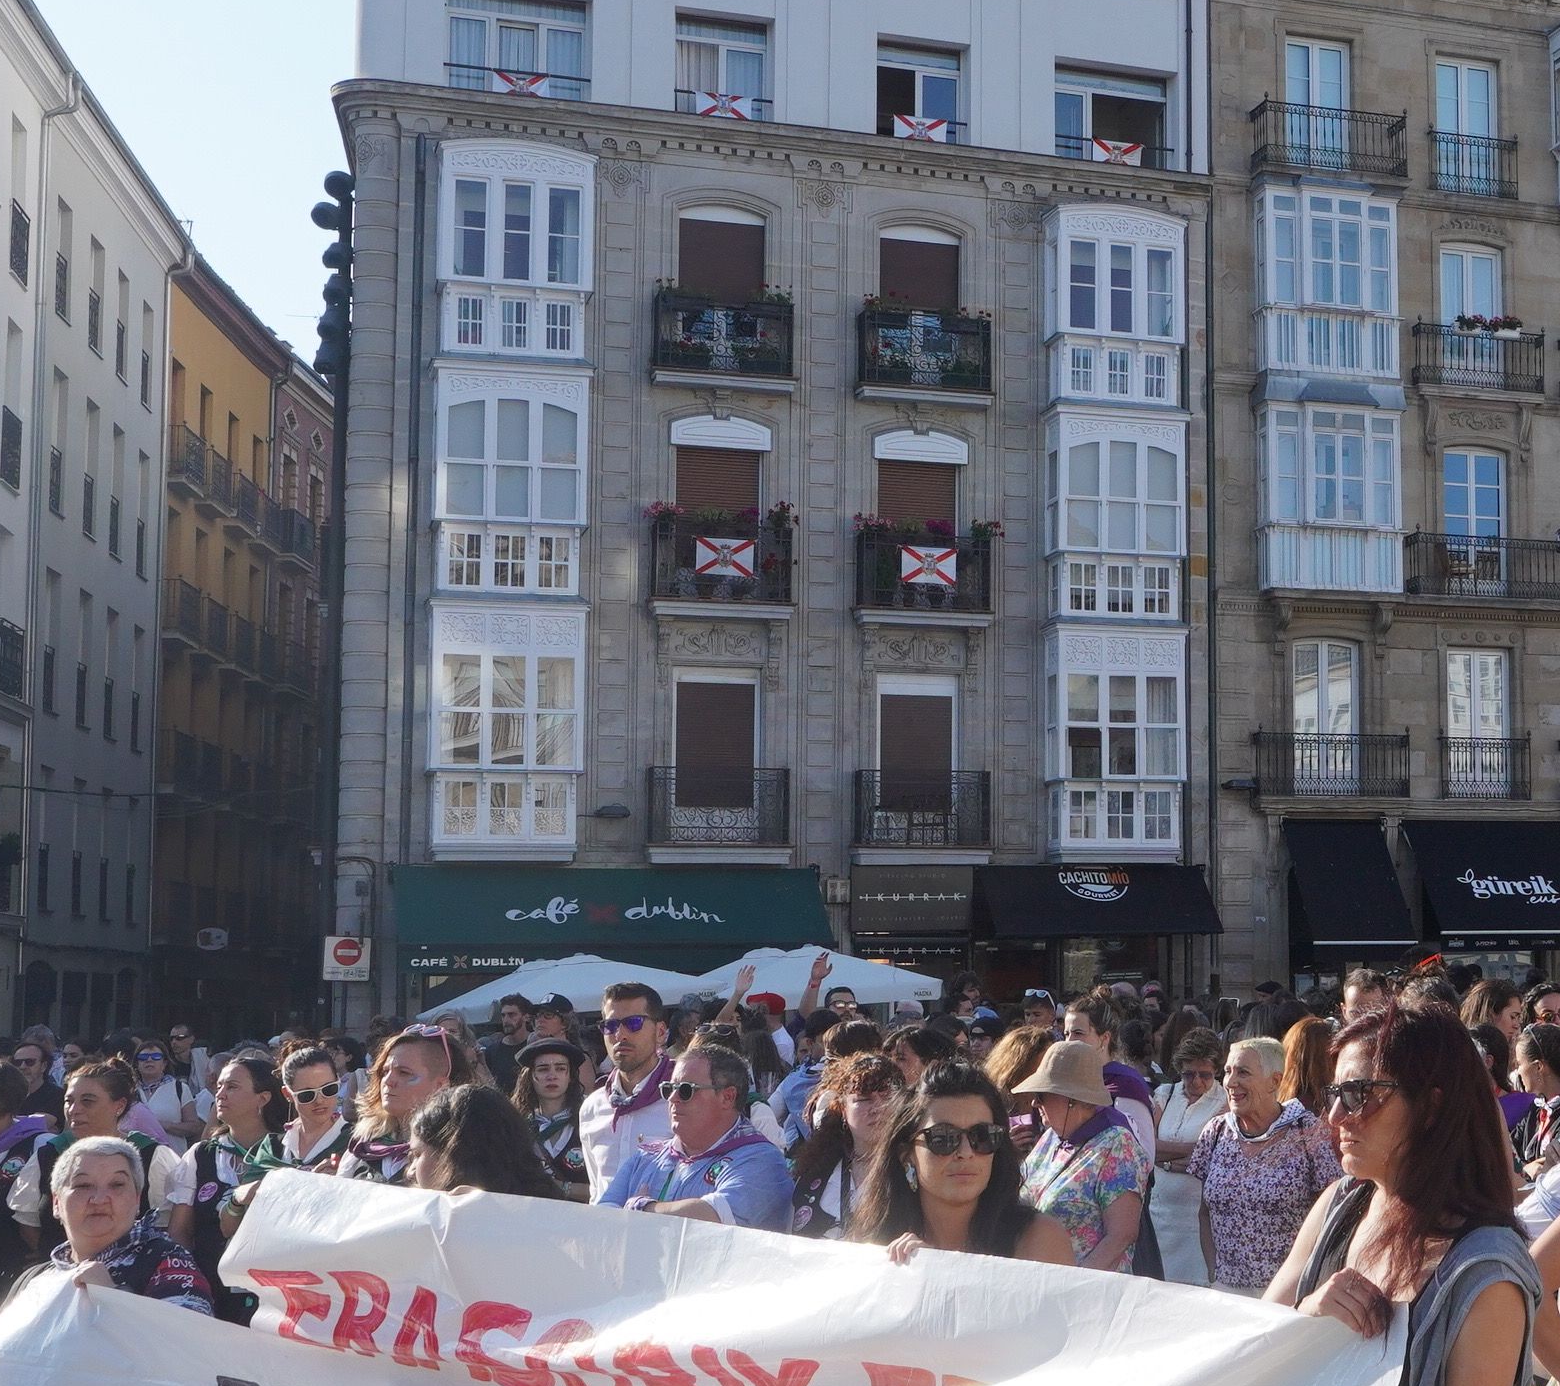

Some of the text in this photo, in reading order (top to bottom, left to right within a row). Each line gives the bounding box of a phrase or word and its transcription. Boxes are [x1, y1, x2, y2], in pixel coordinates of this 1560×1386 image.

[1077, 887, 1120, 900] GOURMET
[1470, 875, 1559, 899] güreik
[505, 896, 580, 924] café
[410, 957, 448, 967] CAFÉ
